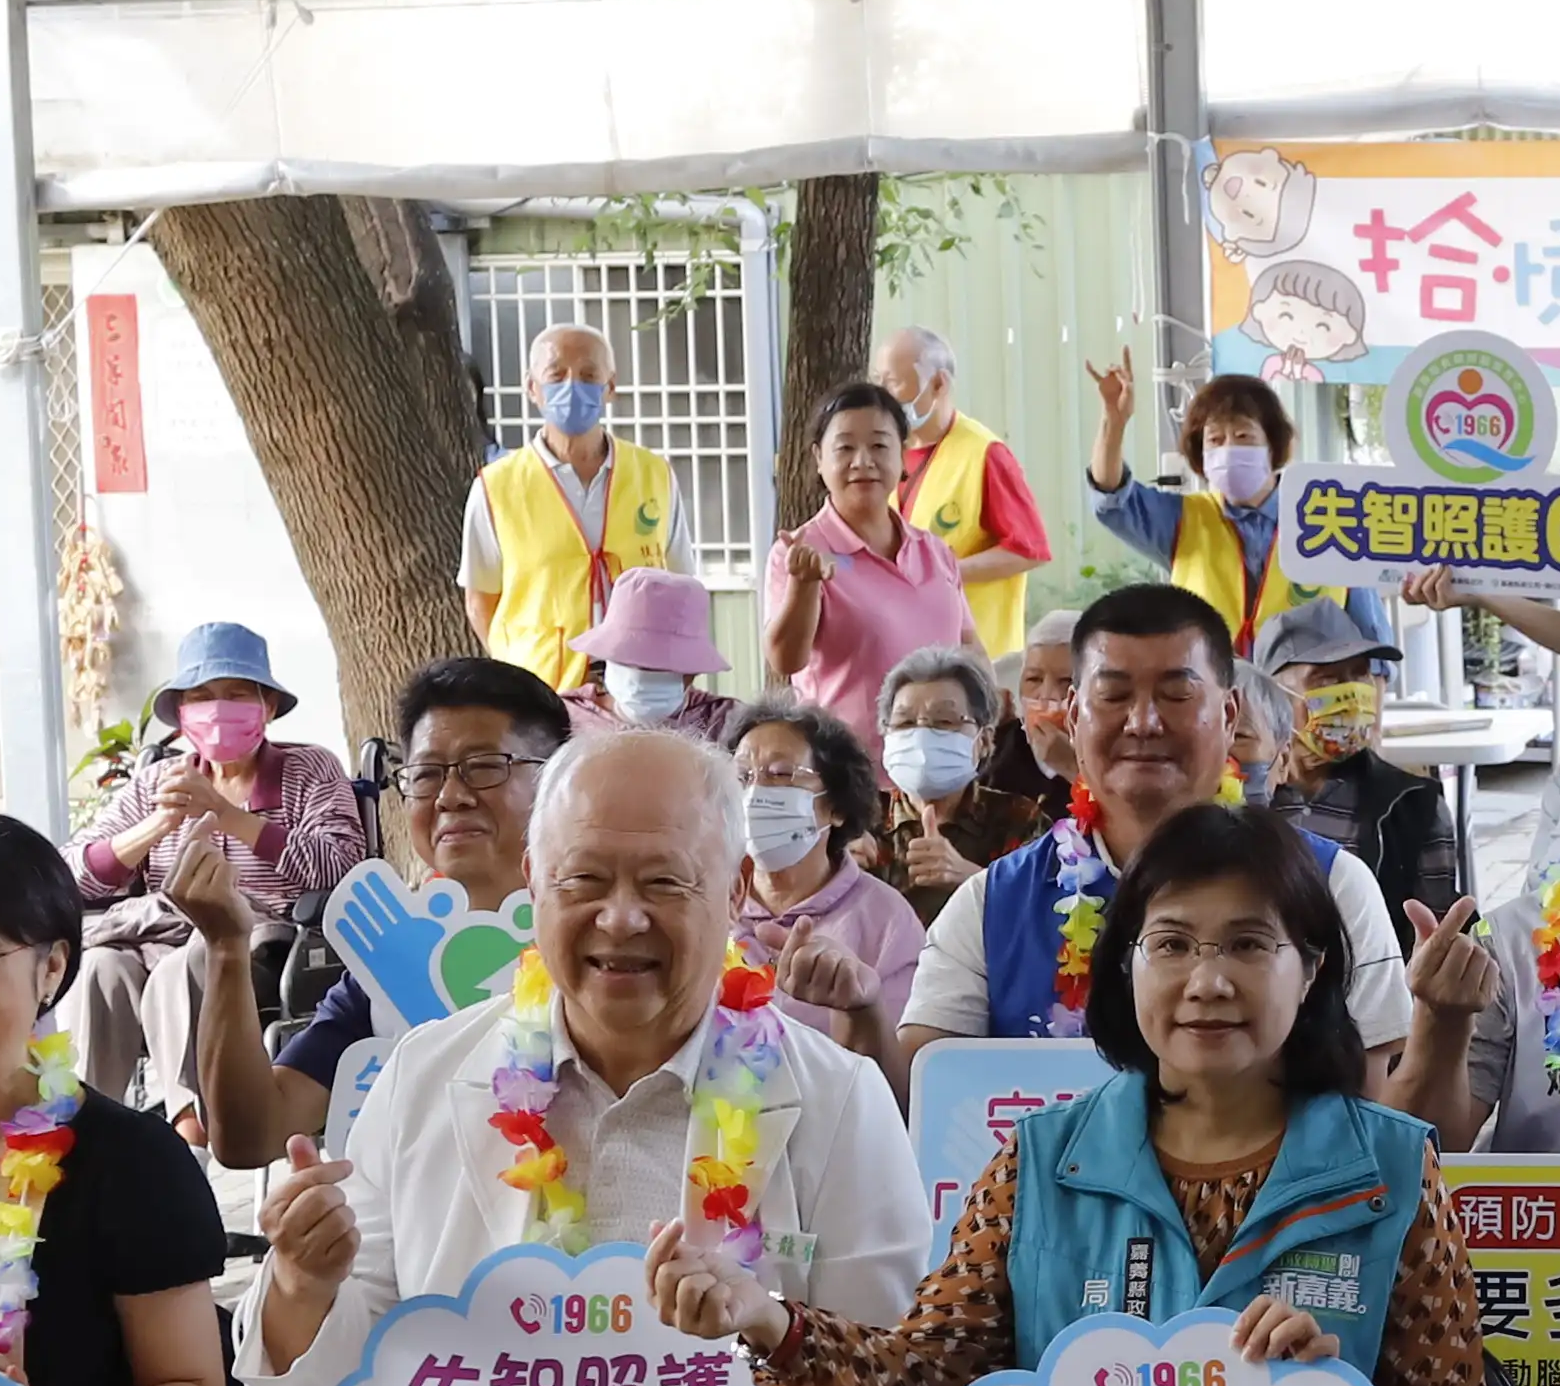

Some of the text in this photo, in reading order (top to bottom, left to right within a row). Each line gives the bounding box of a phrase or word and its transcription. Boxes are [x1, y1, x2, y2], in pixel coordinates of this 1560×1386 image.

[1454, 413, 1502, 437] 1966
[1080, 1279, 1109, 1309] 局
[550, 1293, 633, 1335] 1966
